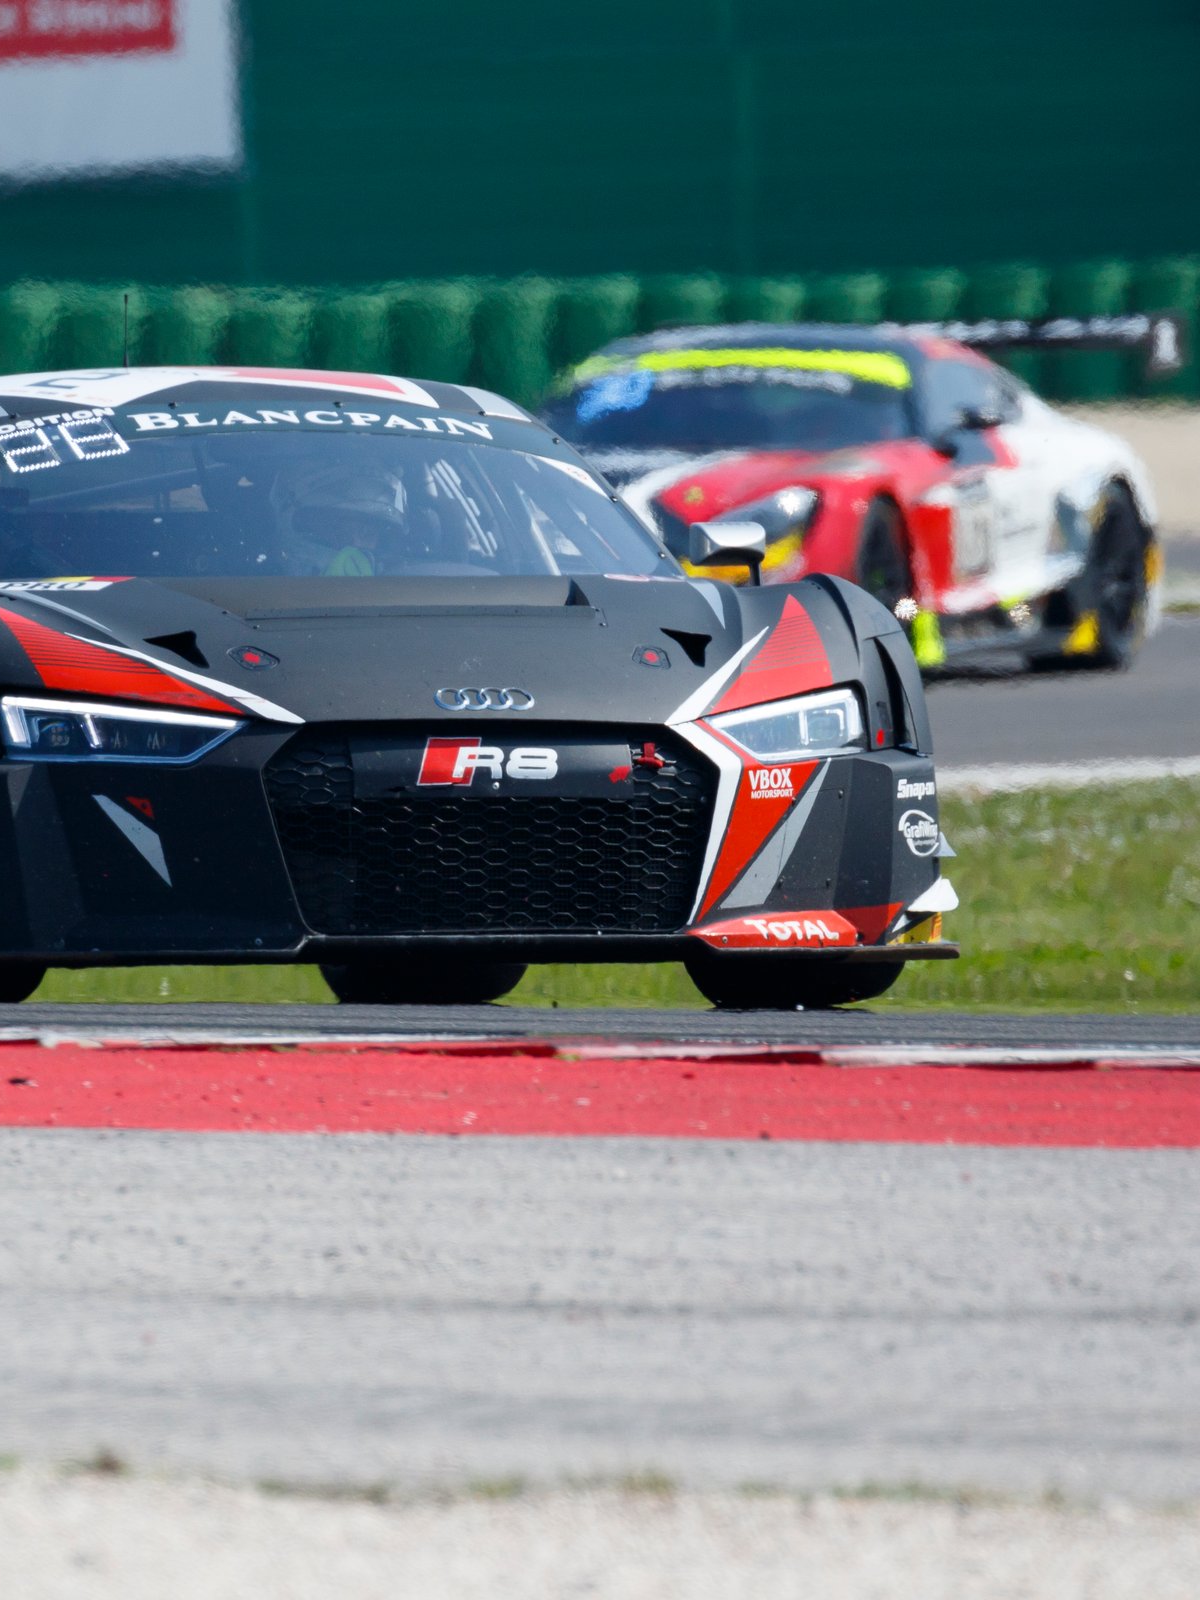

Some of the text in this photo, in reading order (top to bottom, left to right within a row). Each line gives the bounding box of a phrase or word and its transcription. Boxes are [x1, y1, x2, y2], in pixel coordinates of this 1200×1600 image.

[127, 409, 494, 440] BLANCPAIN
[1, 582, 87, 591] PRO
[452, 746, 558, 780] R8
[748, 767, 793, 790] VBOX
[750, 788, 794, 800] MOTORSPORT
[743, 919, 840, 941] TOTAL
